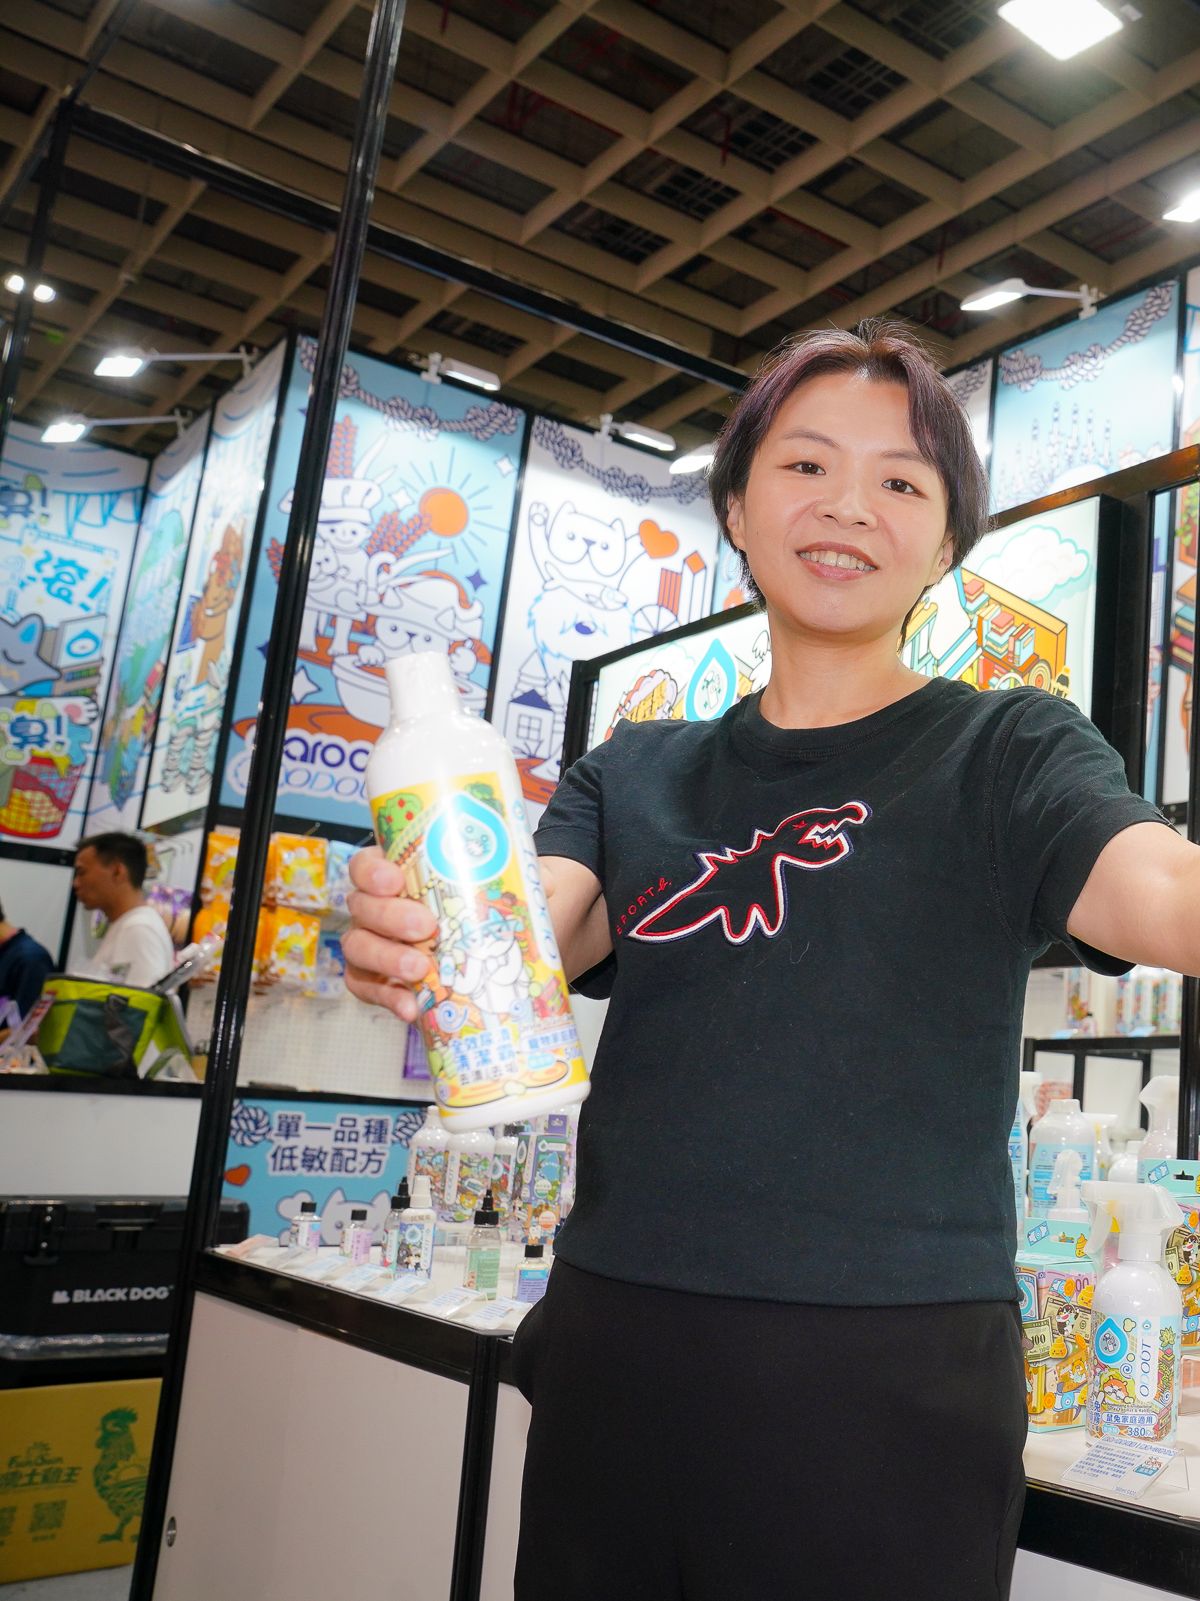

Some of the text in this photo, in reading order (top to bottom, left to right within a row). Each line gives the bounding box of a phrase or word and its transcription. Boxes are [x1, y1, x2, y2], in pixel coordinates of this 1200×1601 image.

[275, 1113, 389, 1145] 單一品種
[271, 1145, 387, 1175] 低敏配方
[72, 1286, 170, 1303] BLACK DOG
[1140, 1341, 1152, 1398] ODOUT
